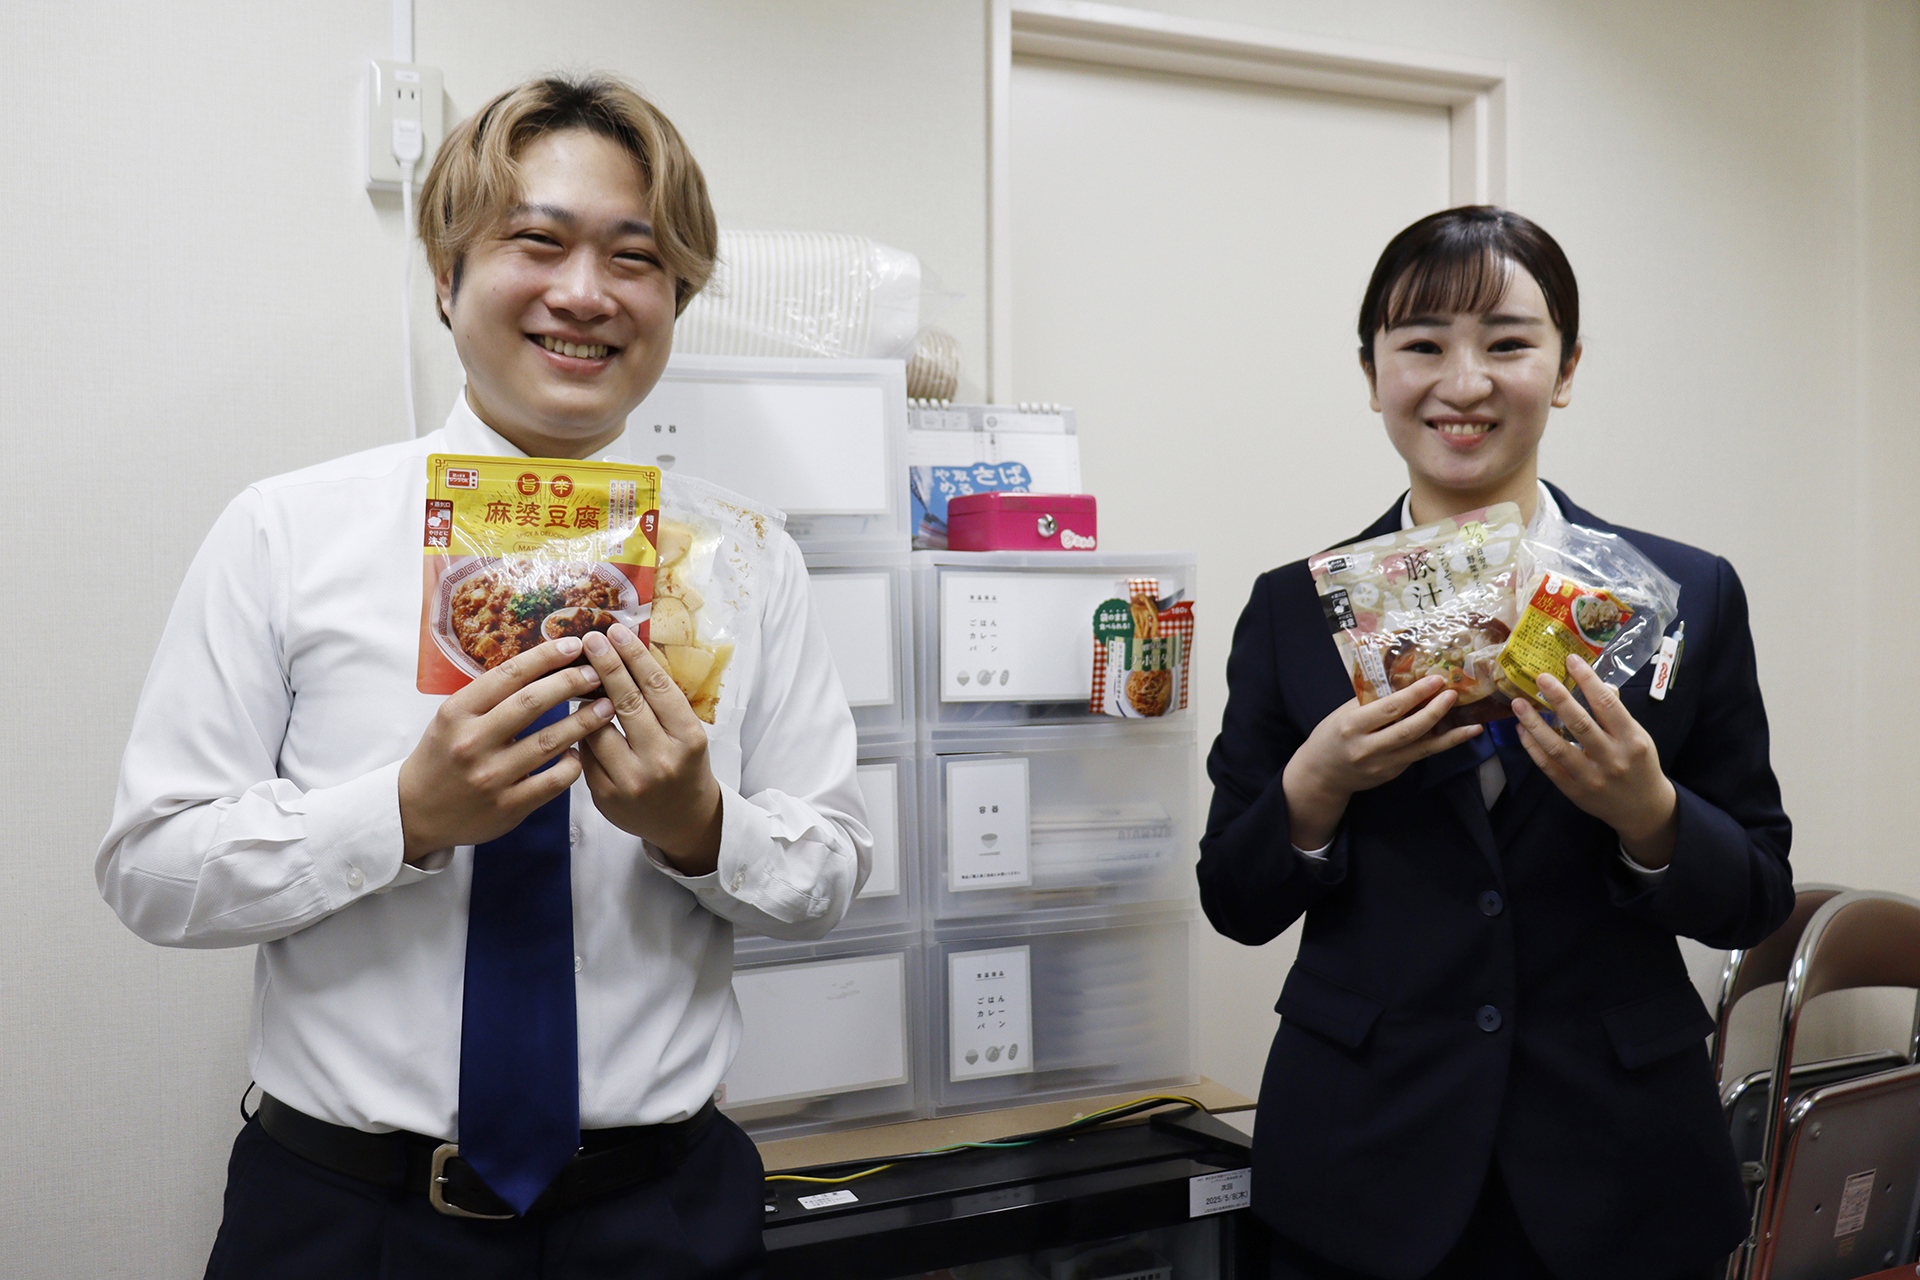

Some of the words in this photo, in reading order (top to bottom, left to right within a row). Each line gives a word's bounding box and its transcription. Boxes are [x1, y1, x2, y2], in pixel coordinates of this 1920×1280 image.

[972, 464, 1027, 486] さば
[484, 500, 600, 530] 麻婆豆腐
[645, 514, 655, 532] 持つ
[428, 536, 448, 546] 注意
[1403, 549, 1443, 614] 豚汁
[1535, 593, 1569, 621] 焼売
[1100, 613, 1128, 622] 袋のまま
[970, 632, 997, 640] カレー
[977, 995, 1005, 1005] ごはん
[977, 1009, 1006, 1018] カレー
